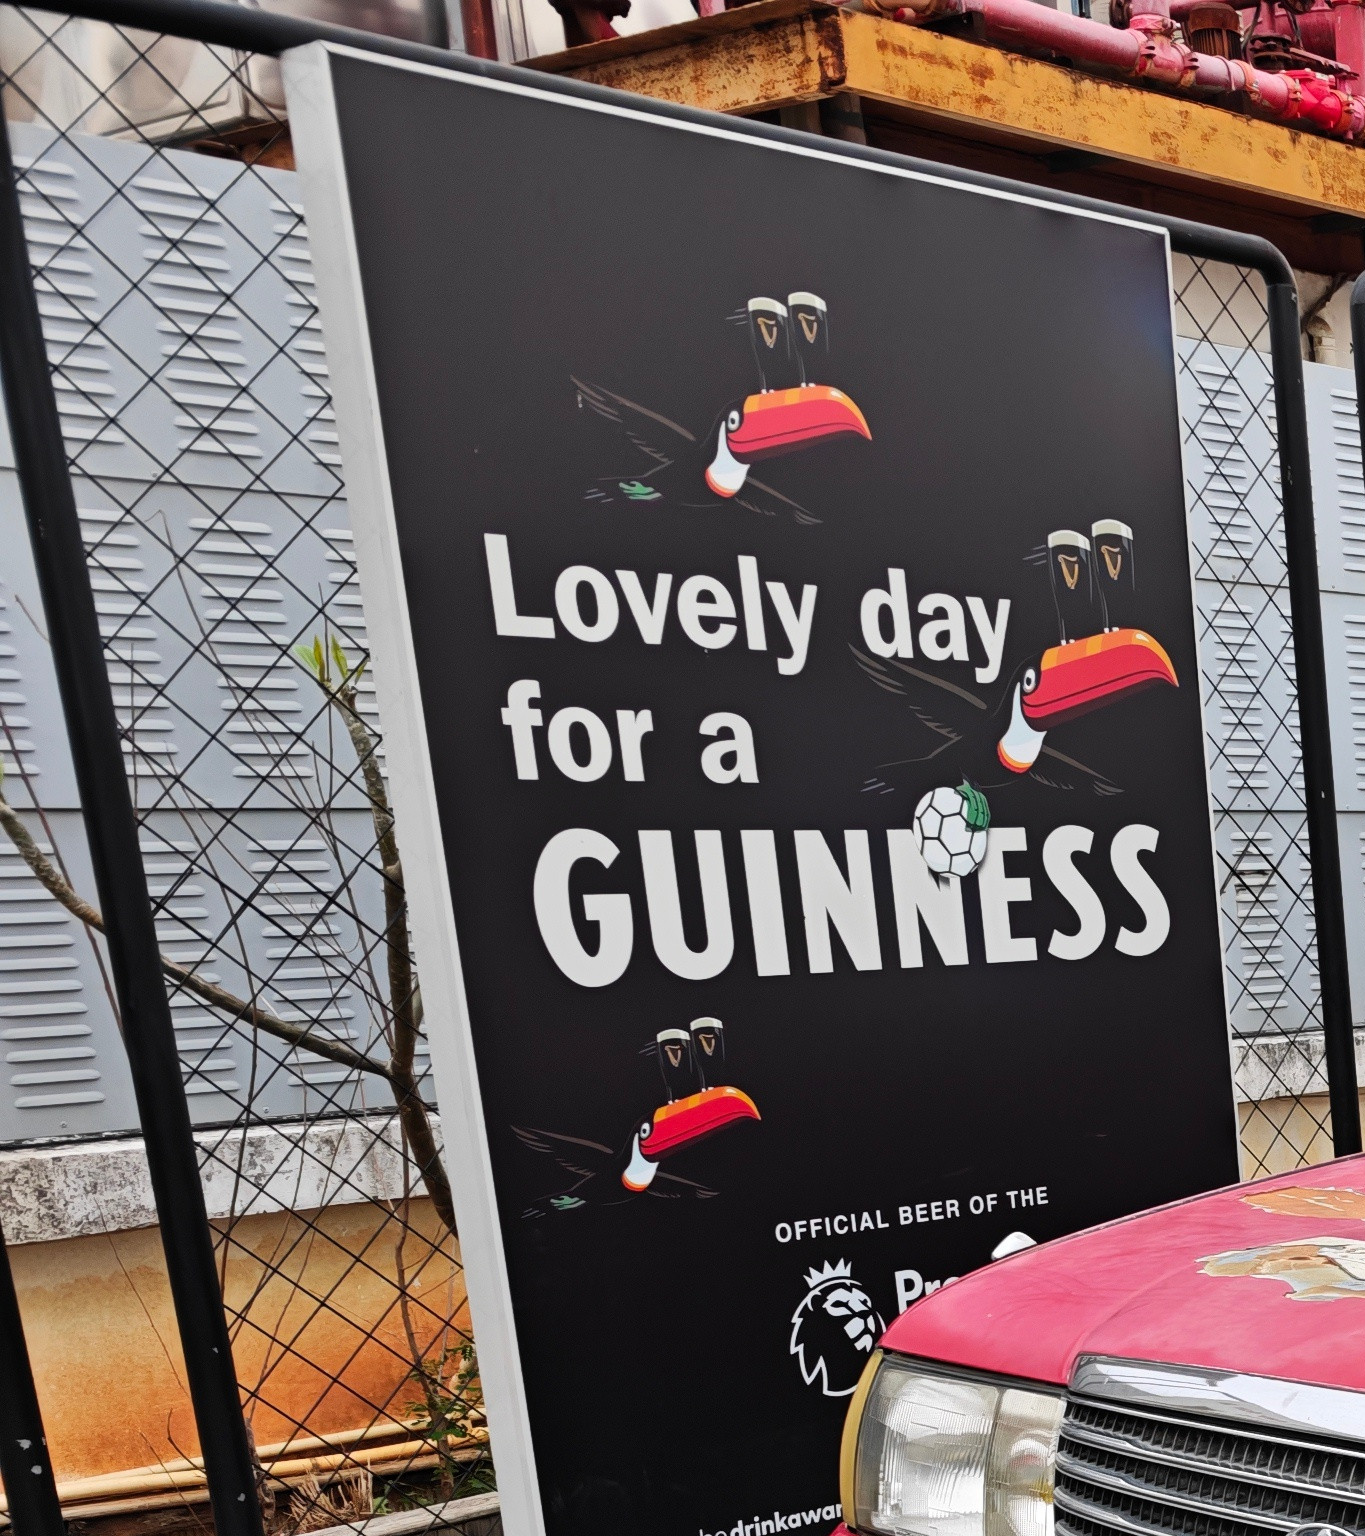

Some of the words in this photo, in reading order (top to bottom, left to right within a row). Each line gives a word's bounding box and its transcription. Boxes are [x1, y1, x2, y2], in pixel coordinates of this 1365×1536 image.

[483, 531, 818, 676] Lovely
[859, 567, 1012, 684] day
[500, 678, 655, 784] for
[698, 711, 760, 784] a
[532, 823, 1172, 989] GUINNESS
[775, 1207, 889, 1243] OFFICIAL
[898, 1199, 960, 1226] BEER
[969, 1192, 998, 1215] OF
[1005, 1185, 1049, 1209] THE
[894, 1269, 960, 1315] Pr
